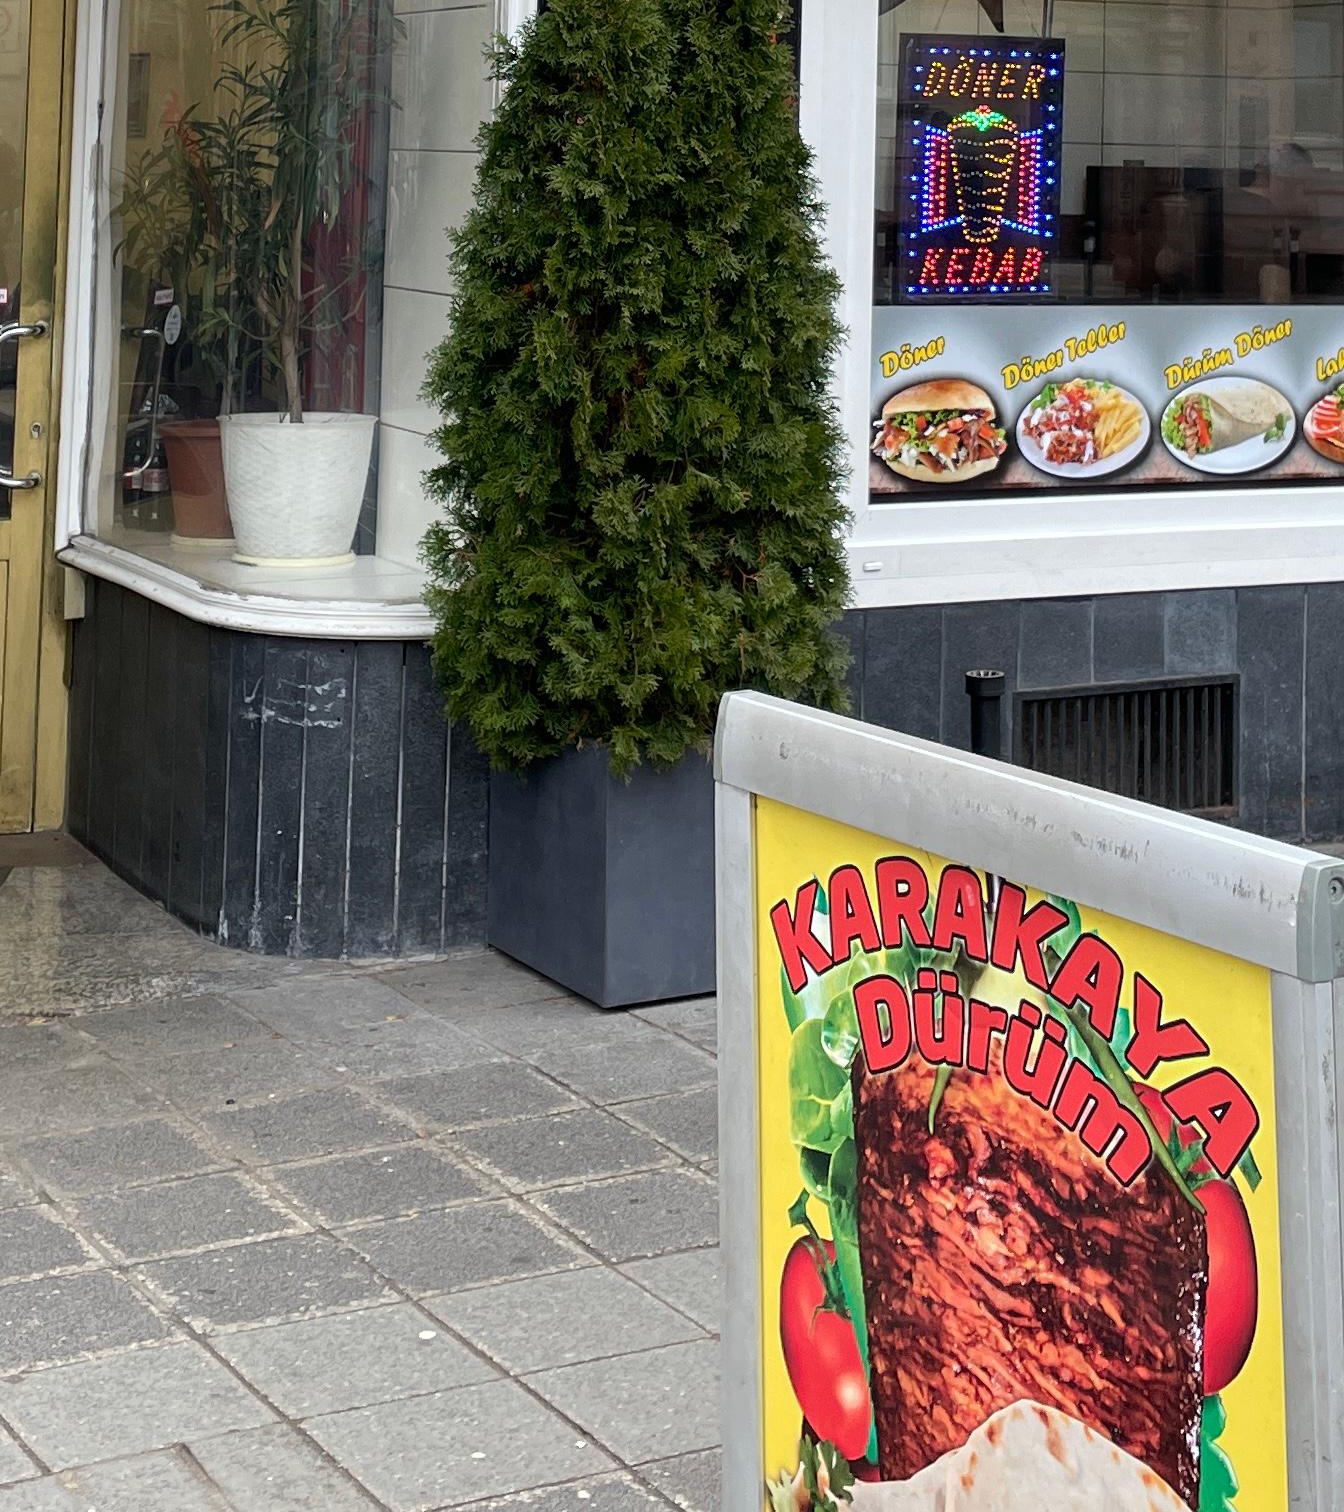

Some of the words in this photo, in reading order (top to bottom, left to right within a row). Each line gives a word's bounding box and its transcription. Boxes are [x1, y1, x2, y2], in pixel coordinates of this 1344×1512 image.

[919, 246, 1044, 285] KEBAB
[880, 336, 945, 378] Döner
[1001, 349, 1063, 389] Döner
[1064, 321, 1126, 361] Teller
[1164, 346, 1233, 389] Dürüm
[1234, 319, 1292, 358] Döner
[771, 855, 1260, 1177] KARAKAYA
[853, 969, 1153, 1188] Dürüm
